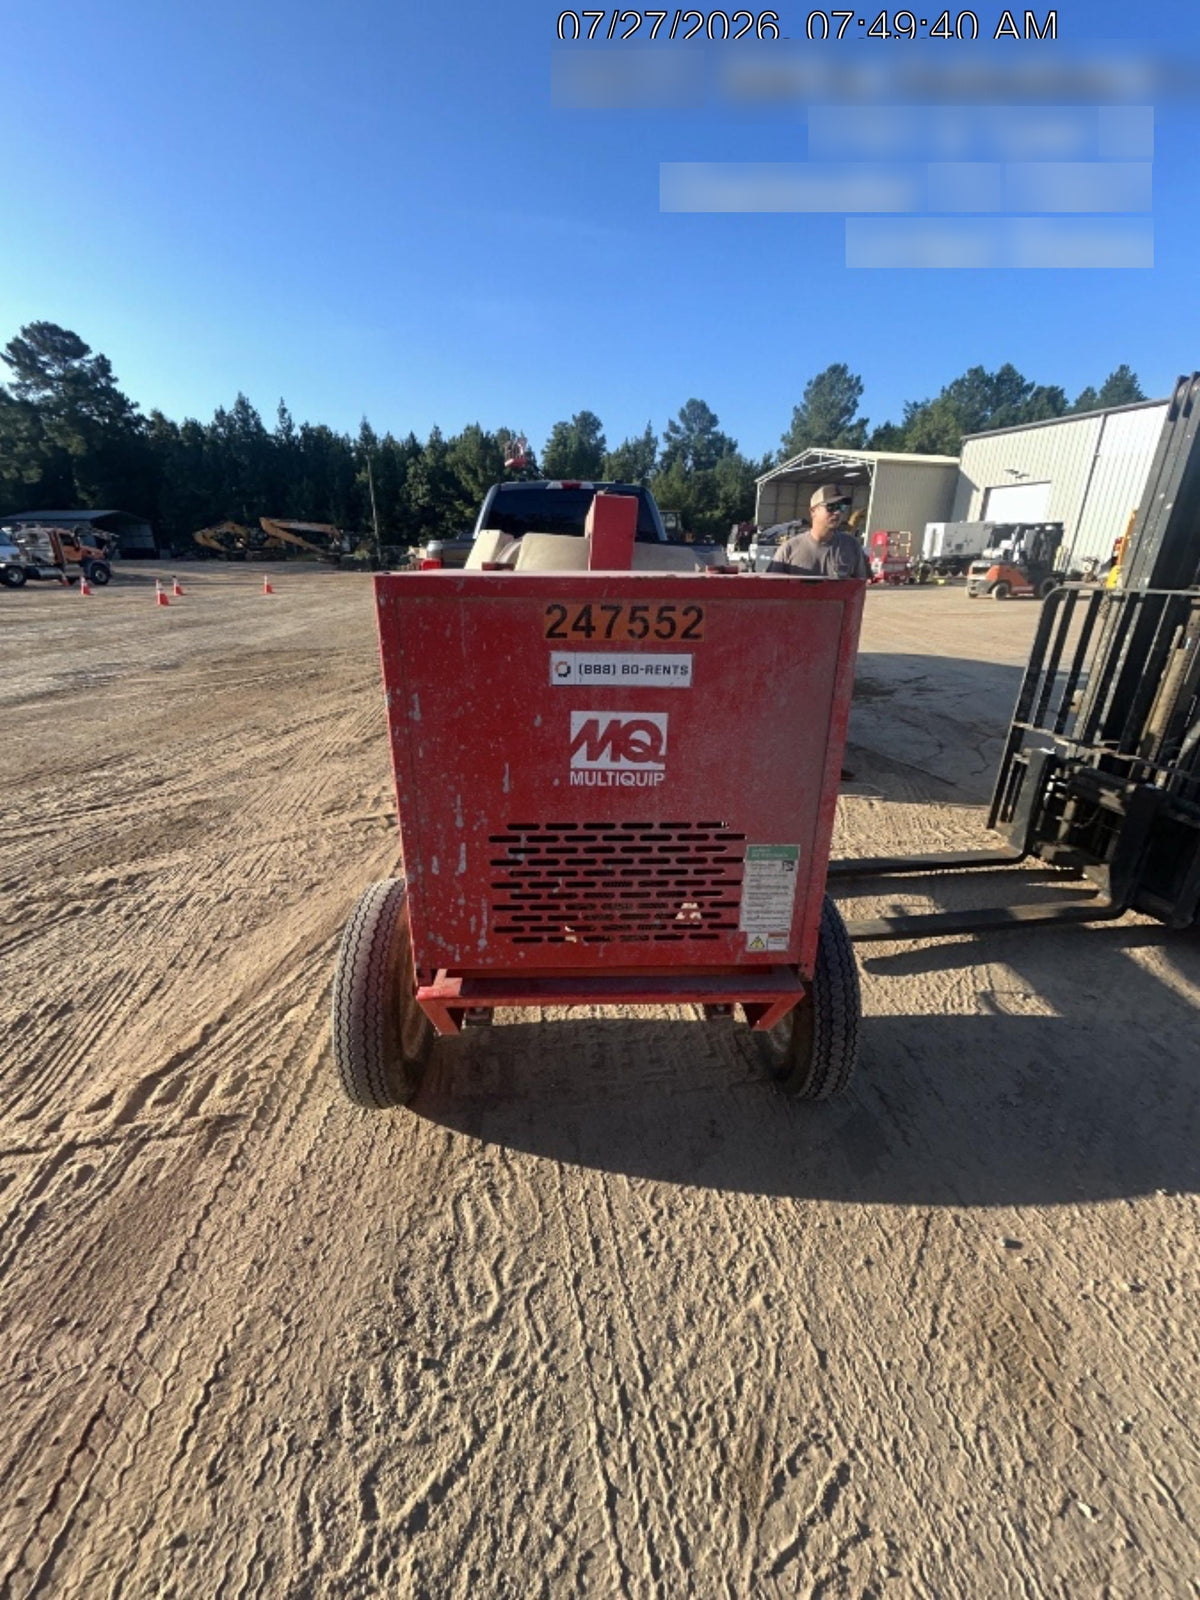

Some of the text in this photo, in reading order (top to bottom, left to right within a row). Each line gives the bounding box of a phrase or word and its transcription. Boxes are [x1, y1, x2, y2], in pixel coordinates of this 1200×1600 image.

[545, 604, 704, 639] 247552
[570, 718, 665, 764] MQ
[569, 771, 665, 787] MULTIQUIP
